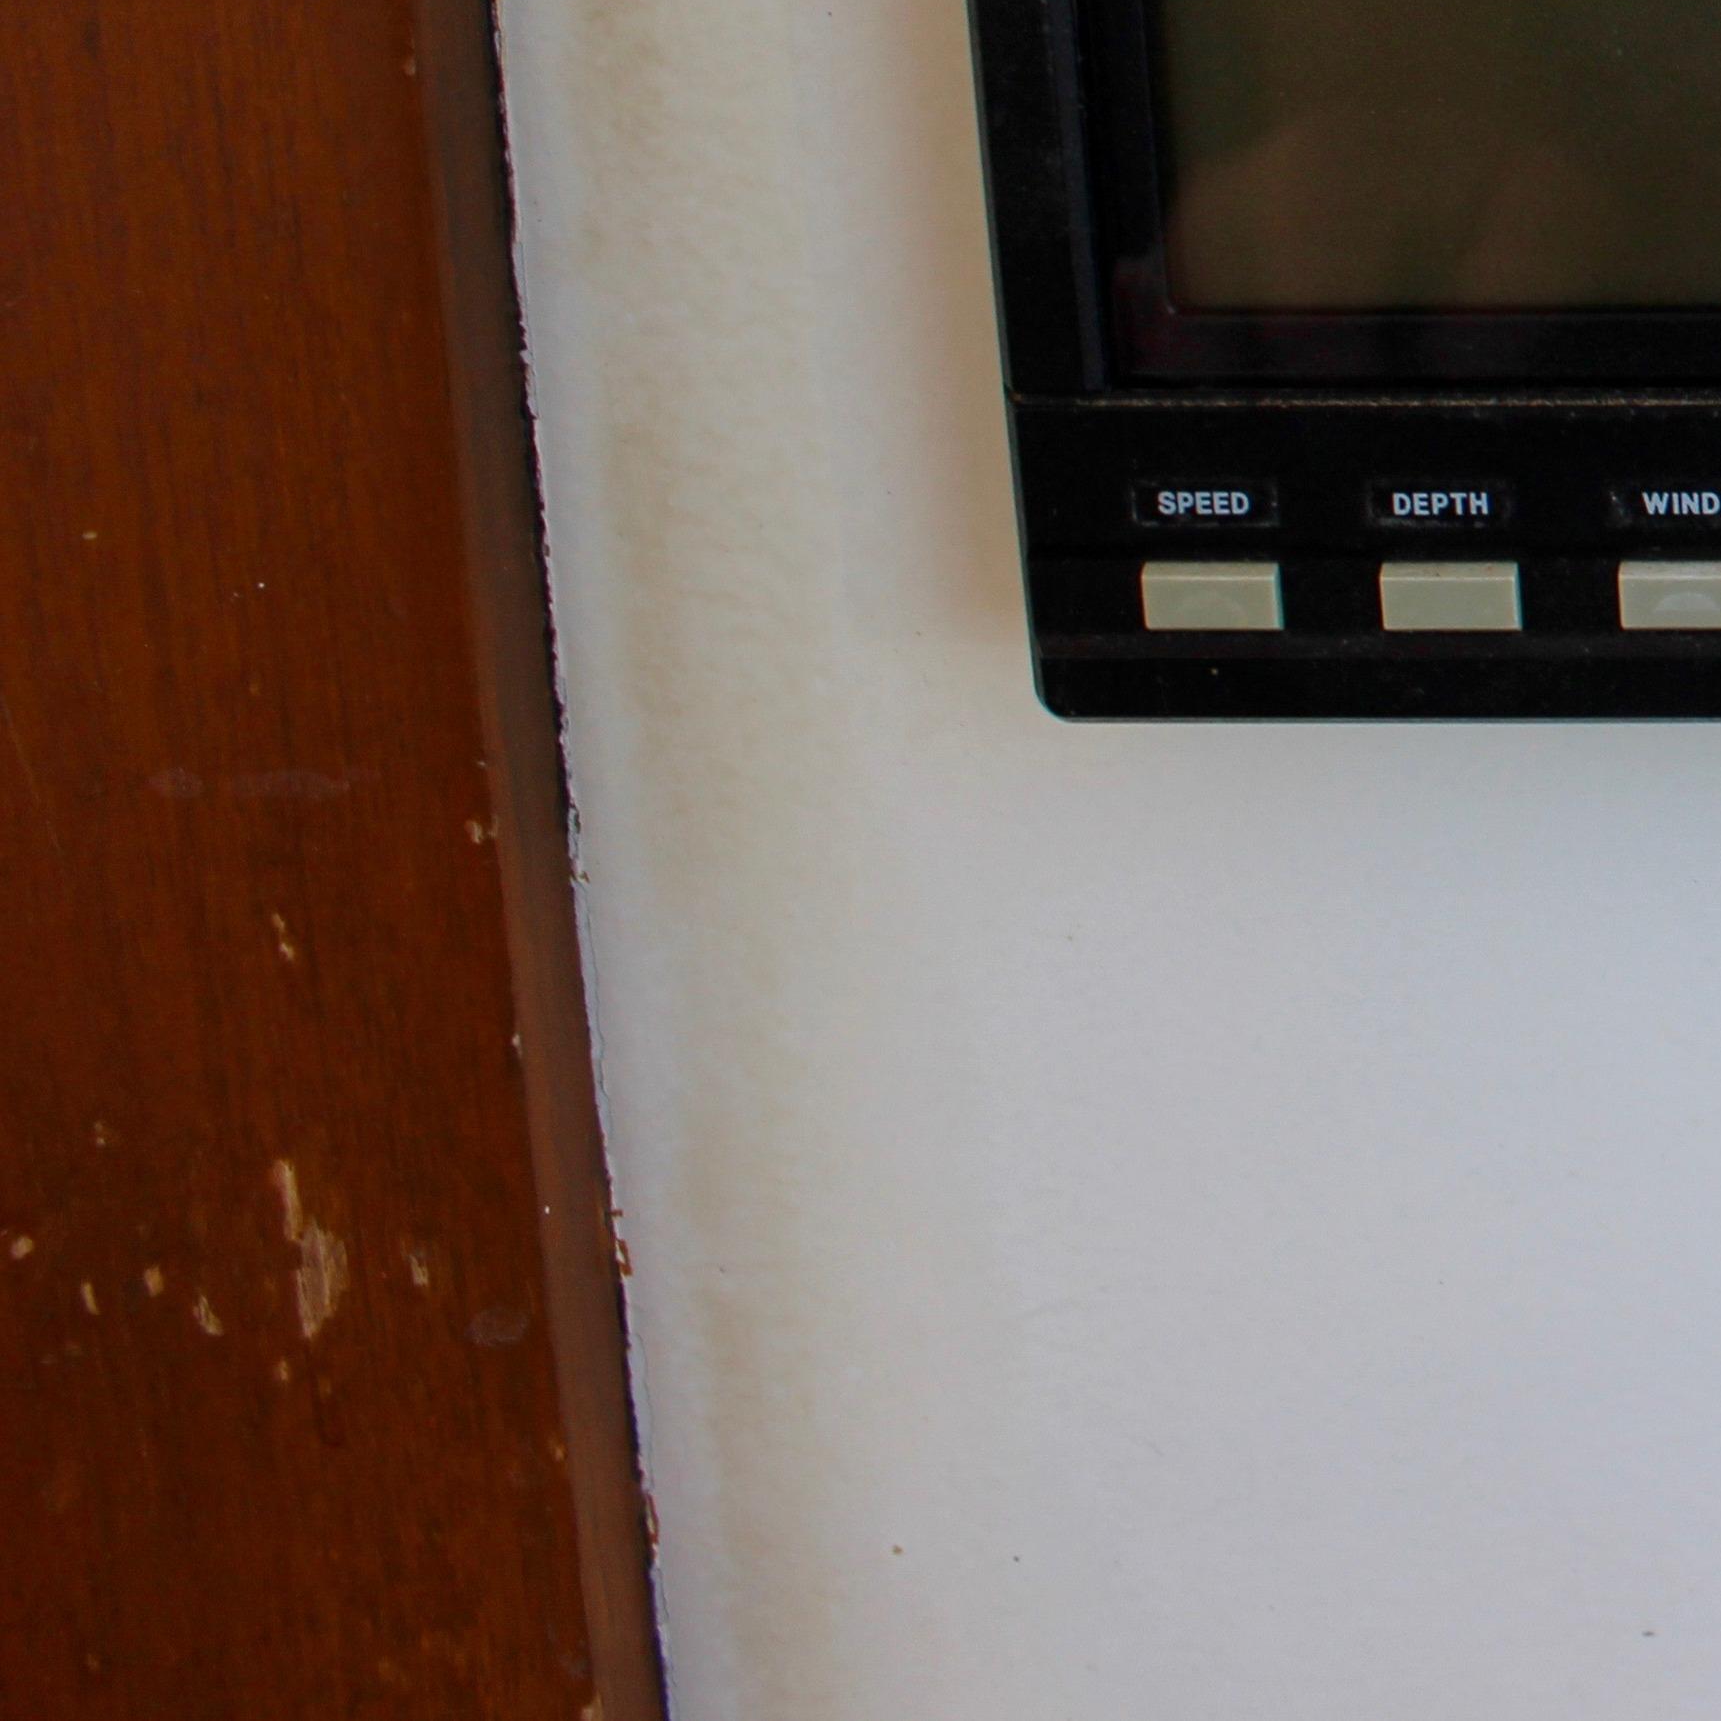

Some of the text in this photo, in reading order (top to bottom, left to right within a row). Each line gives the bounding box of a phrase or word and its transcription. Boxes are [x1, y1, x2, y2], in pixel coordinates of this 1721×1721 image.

[1156, 490, 1250, 516] SPEED
[1392, 491, 1489, 516] DEPTH
[1641, 491, 1721, 516] WIND
